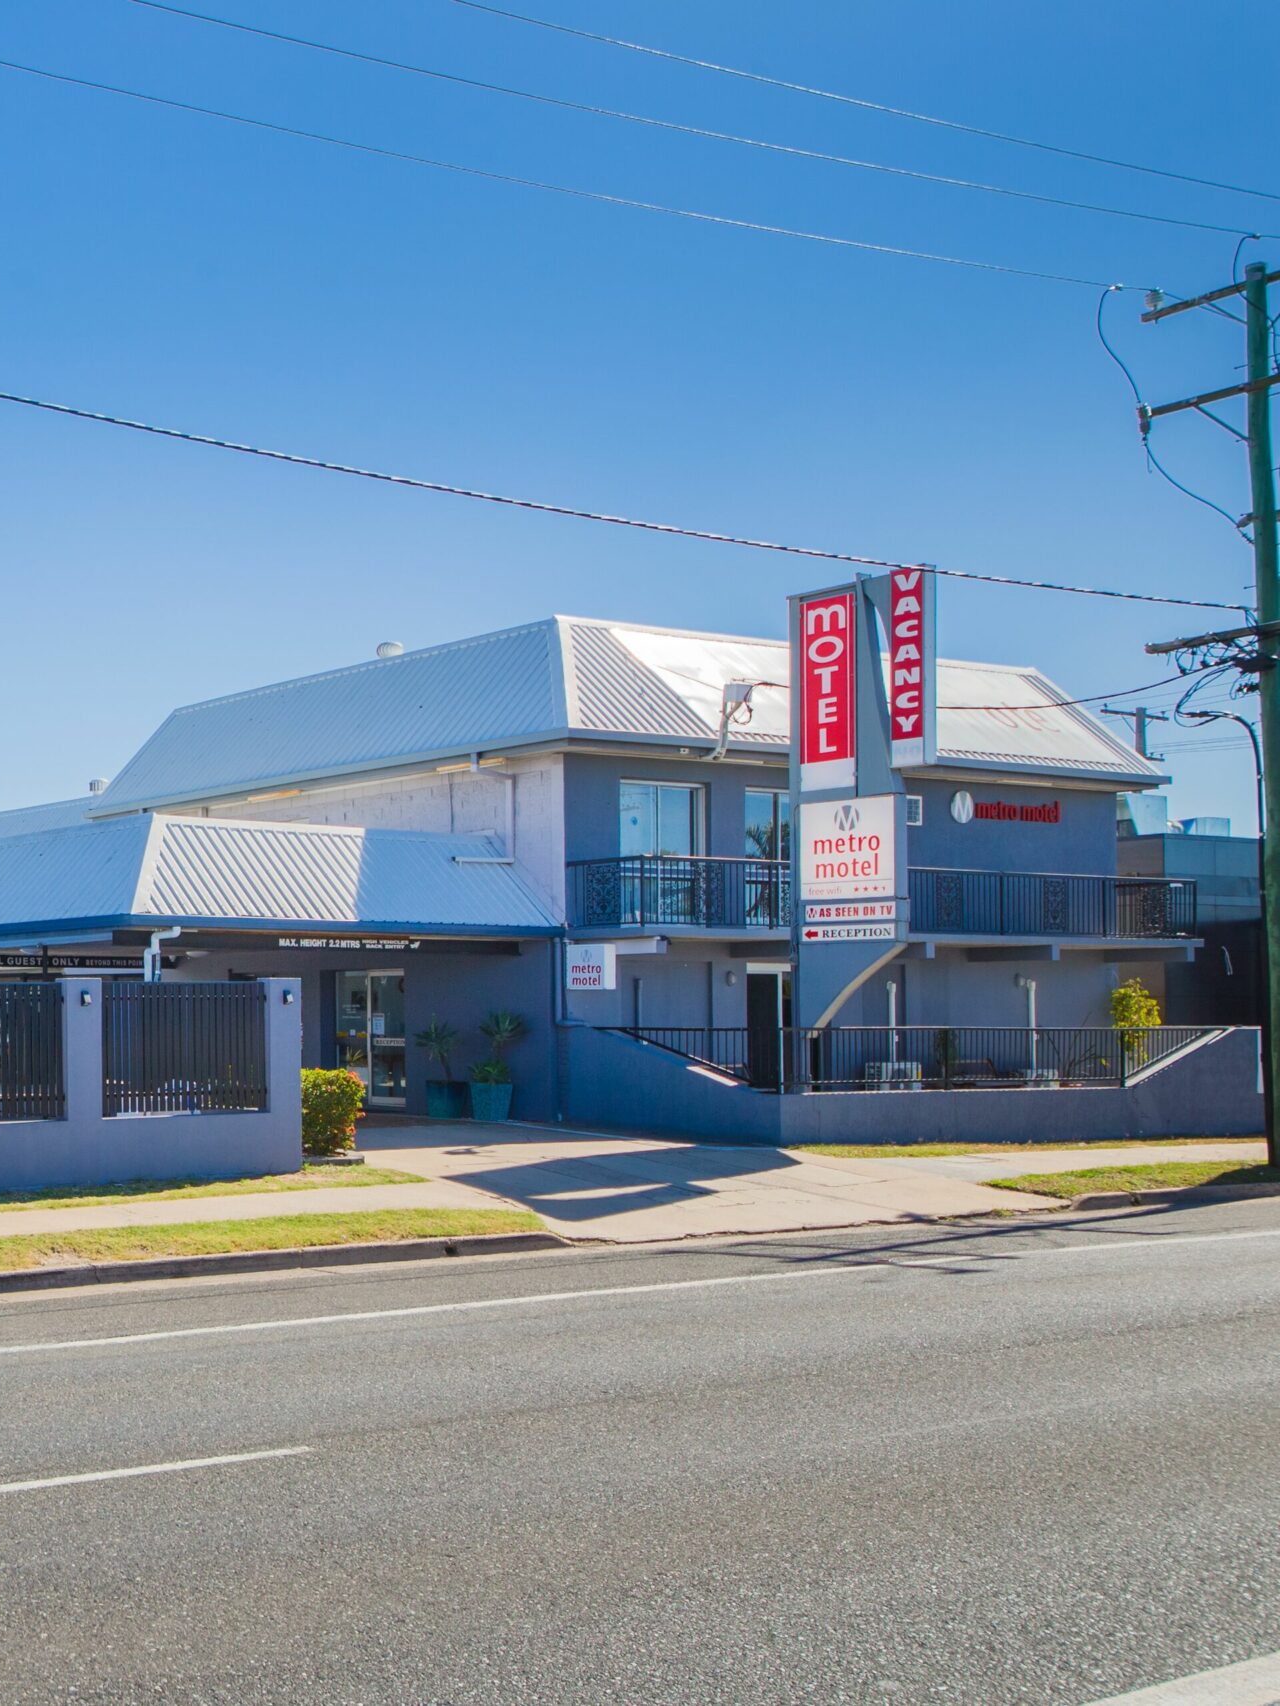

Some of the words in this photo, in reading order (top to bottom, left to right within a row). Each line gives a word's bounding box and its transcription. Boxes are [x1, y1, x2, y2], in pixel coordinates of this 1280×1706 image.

[894, 570, 921, 733] VACANCY
[975, 801, 1019, 820] metro
[1021, 800, 1061, 823] motel
[813, 834, 880, 855] metro
[815, 853, 879, 879] motel
[819, 908, 831, 918] AS
[835, 907, 859, 917] SEEN
[863, 906, 876, 916] ON
[880, 905, 893, 916] TV
[822, 927, 892, 938] RECEPTION
[278, 938, 298, 947] MAX.
[300, 938, 326, 948] HEIGHT
[7, 956, 49, 966] GUEST
[52, 957, 80, 966] ONLY
[571, 963, 602, 974] metro
[571, 974, 601, 986] motel
